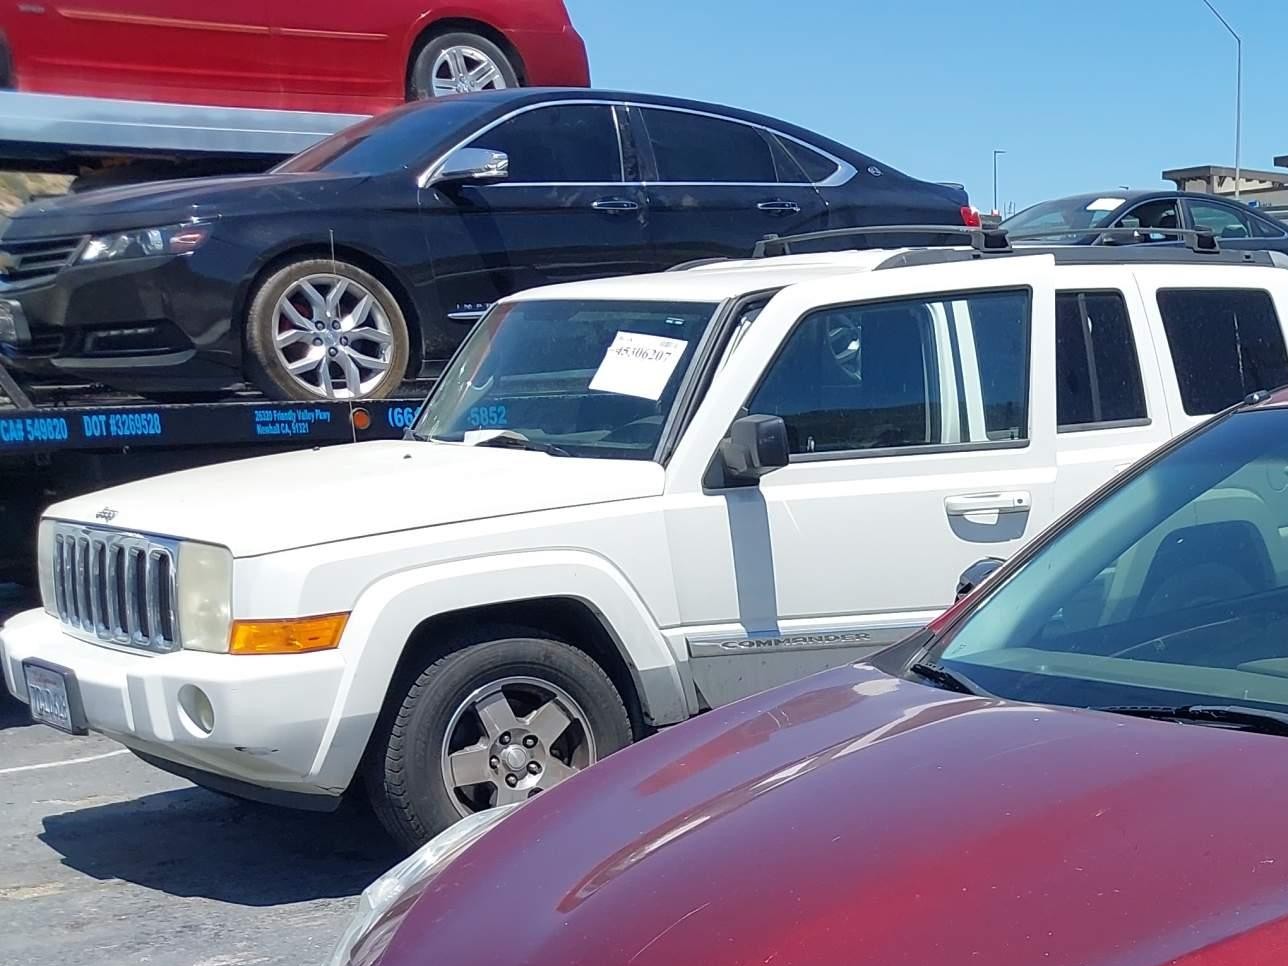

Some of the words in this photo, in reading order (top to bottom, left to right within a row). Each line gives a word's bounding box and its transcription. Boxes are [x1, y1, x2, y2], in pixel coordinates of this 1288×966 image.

[83, 415, 107, 437] DOT
[109, 413, 162, 436] #3269528
[296, 409, 315, 423] Valley
[1, 419, 24, 442] CA#
[26, 418, 68, 441] 549820
[720, 632, 871, 650] COMMANDER
